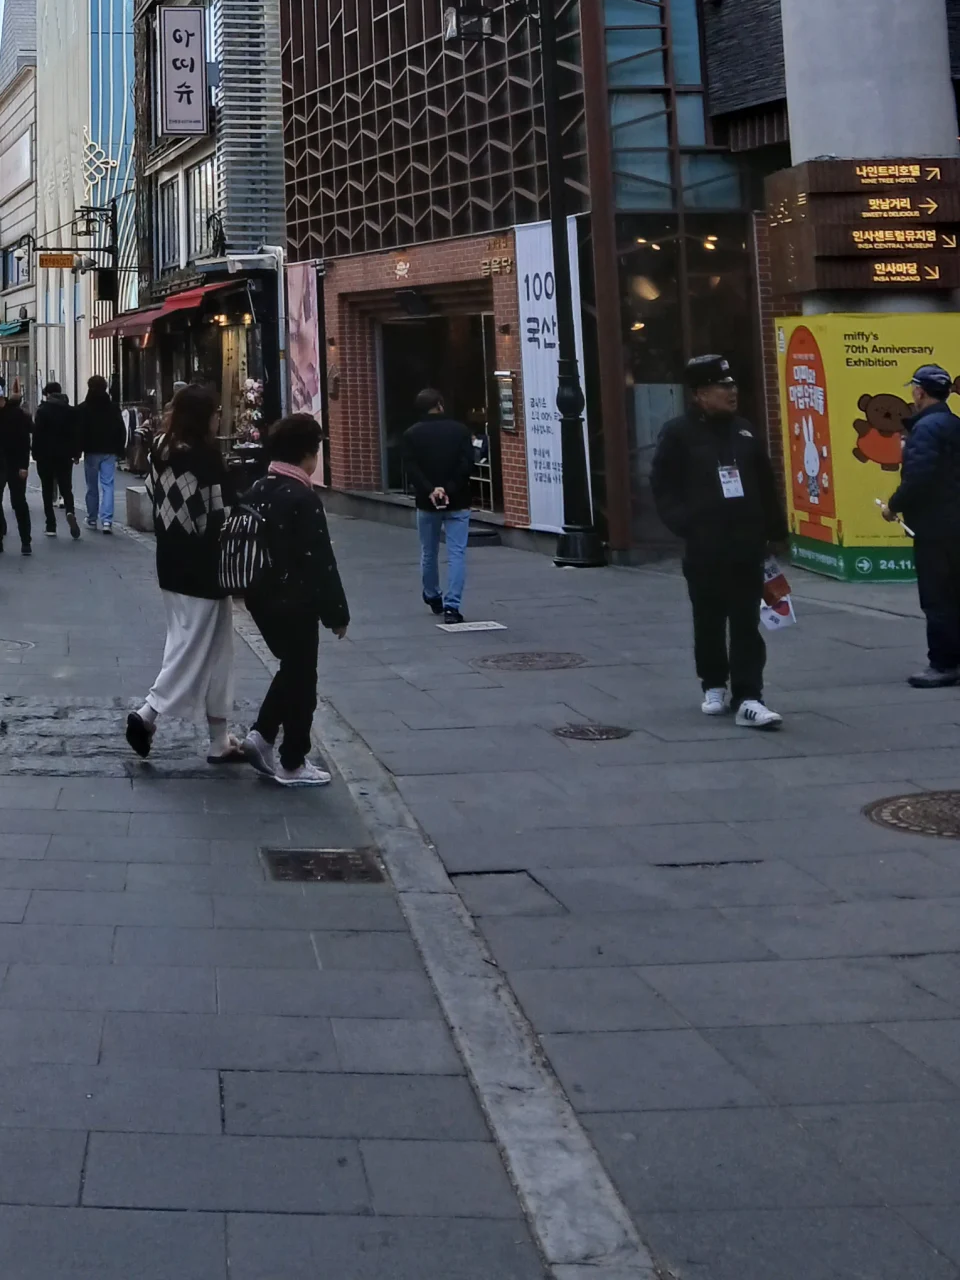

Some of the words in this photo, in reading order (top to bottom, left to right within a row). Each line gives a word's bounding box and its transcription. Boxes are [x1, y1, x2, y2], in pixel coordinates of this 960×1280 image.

[172, 28, 195, 106] 아띠슈
[855, 164, 921, 178] 나인트리호텔
[868, 197, 911, 210] 맛남거리
[852, 230, 937, 242] 인사센트럴뮤지엄
[481, 256, 512, 277] 금옥당
[874, 262, 918, 275] 인사마당
[526, 314, 557, 350] 국산
[844, 331, 879, 344] miffy's
[844, 344, 869, 354] 70th
[871, 344, 934, 355] Anniversary
[846, 357, 898, 367] Exhibition
